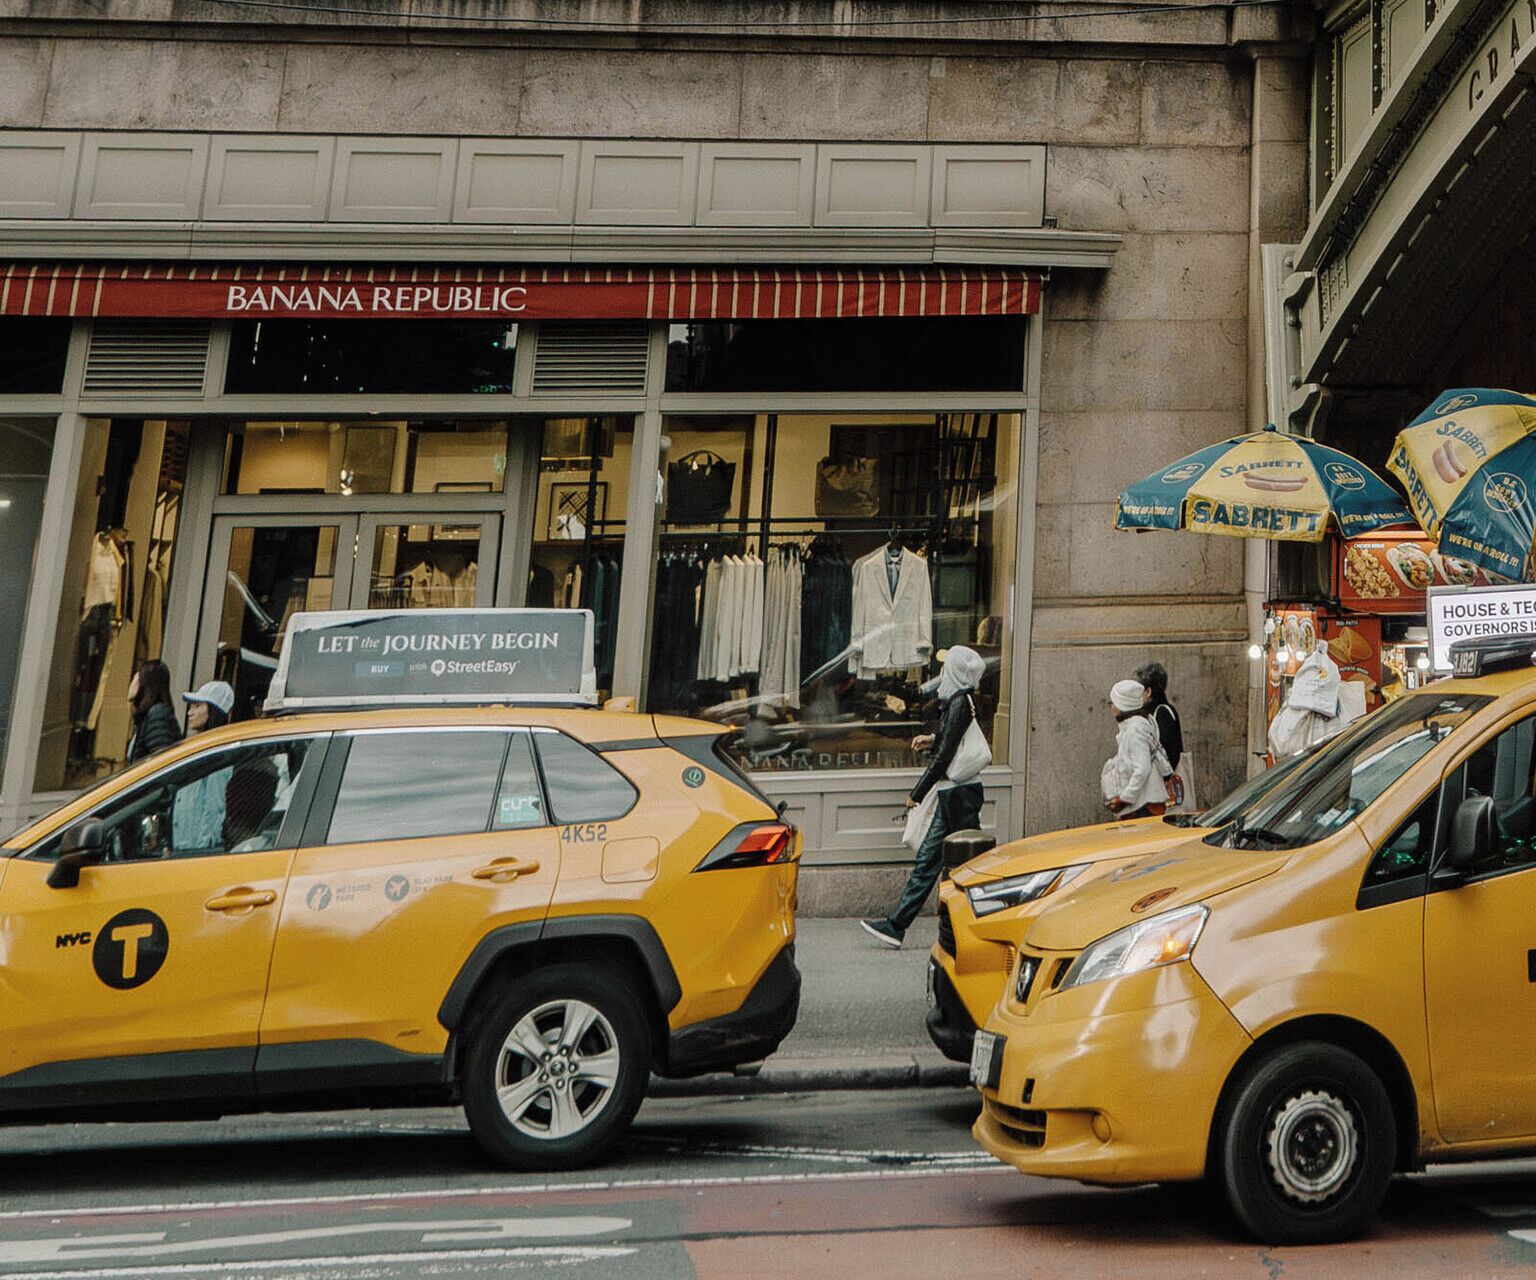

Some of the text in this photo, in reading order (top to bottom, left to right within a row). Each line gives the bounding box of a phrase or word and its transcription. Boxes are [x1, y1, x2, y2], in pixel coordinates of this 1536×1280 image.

[225, 285, 528, 313] BANANA REPUBLIC
[1435, 419, 1488, 461] SABRETT
[1219, 460, 1306, 479] SABRETT
[1191, 499, 1324, 533] SABRETT
[1442, 602, 1497, 619] HOUSE
[1500, 601, 1510, 615] &
[1443, 621, 1528, 638] GOVERNORS
[317, 632, 559, 656] LET the JOURNEY BEGIN
[370, 659, 517, 676] BUY with StreetEasy
[561, 823, 608, 843] 4K52
[55, 931, 93, 949] NYC
[110, 922, 154, 980] T
